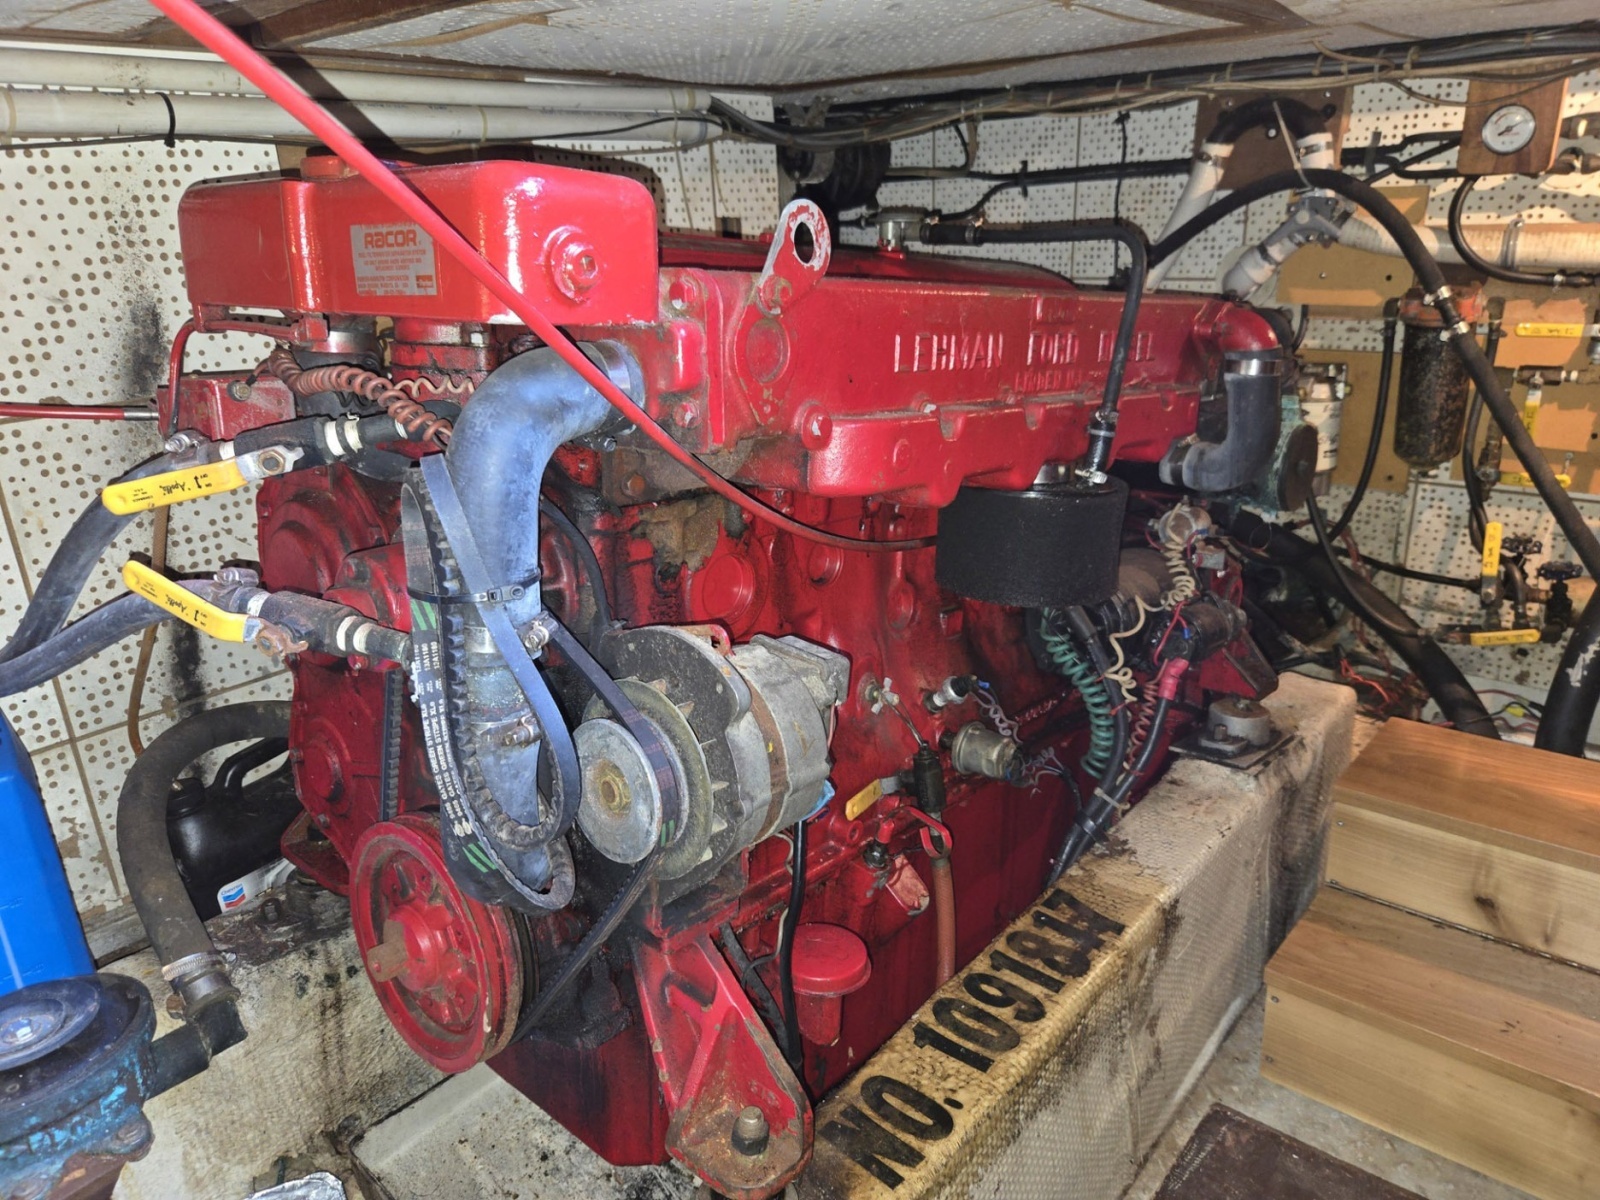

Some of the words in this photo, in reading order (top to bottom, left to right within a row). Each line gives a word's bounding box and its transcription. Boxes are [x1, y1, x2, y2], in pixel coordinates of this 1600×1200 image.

[894, 332, 1003, 373] LEHMAN
[1026, 330, 1080, 366] FORD
[428, 746, 440, 774] GREEN
[436, 745, 448, 771] GREEN
[435, 774, 448, 800] GATES
[443, 771, 455, 797] GATES
[221, 883, 243, 896] Chevron
[819, 1075, 964, 1191] NO.
